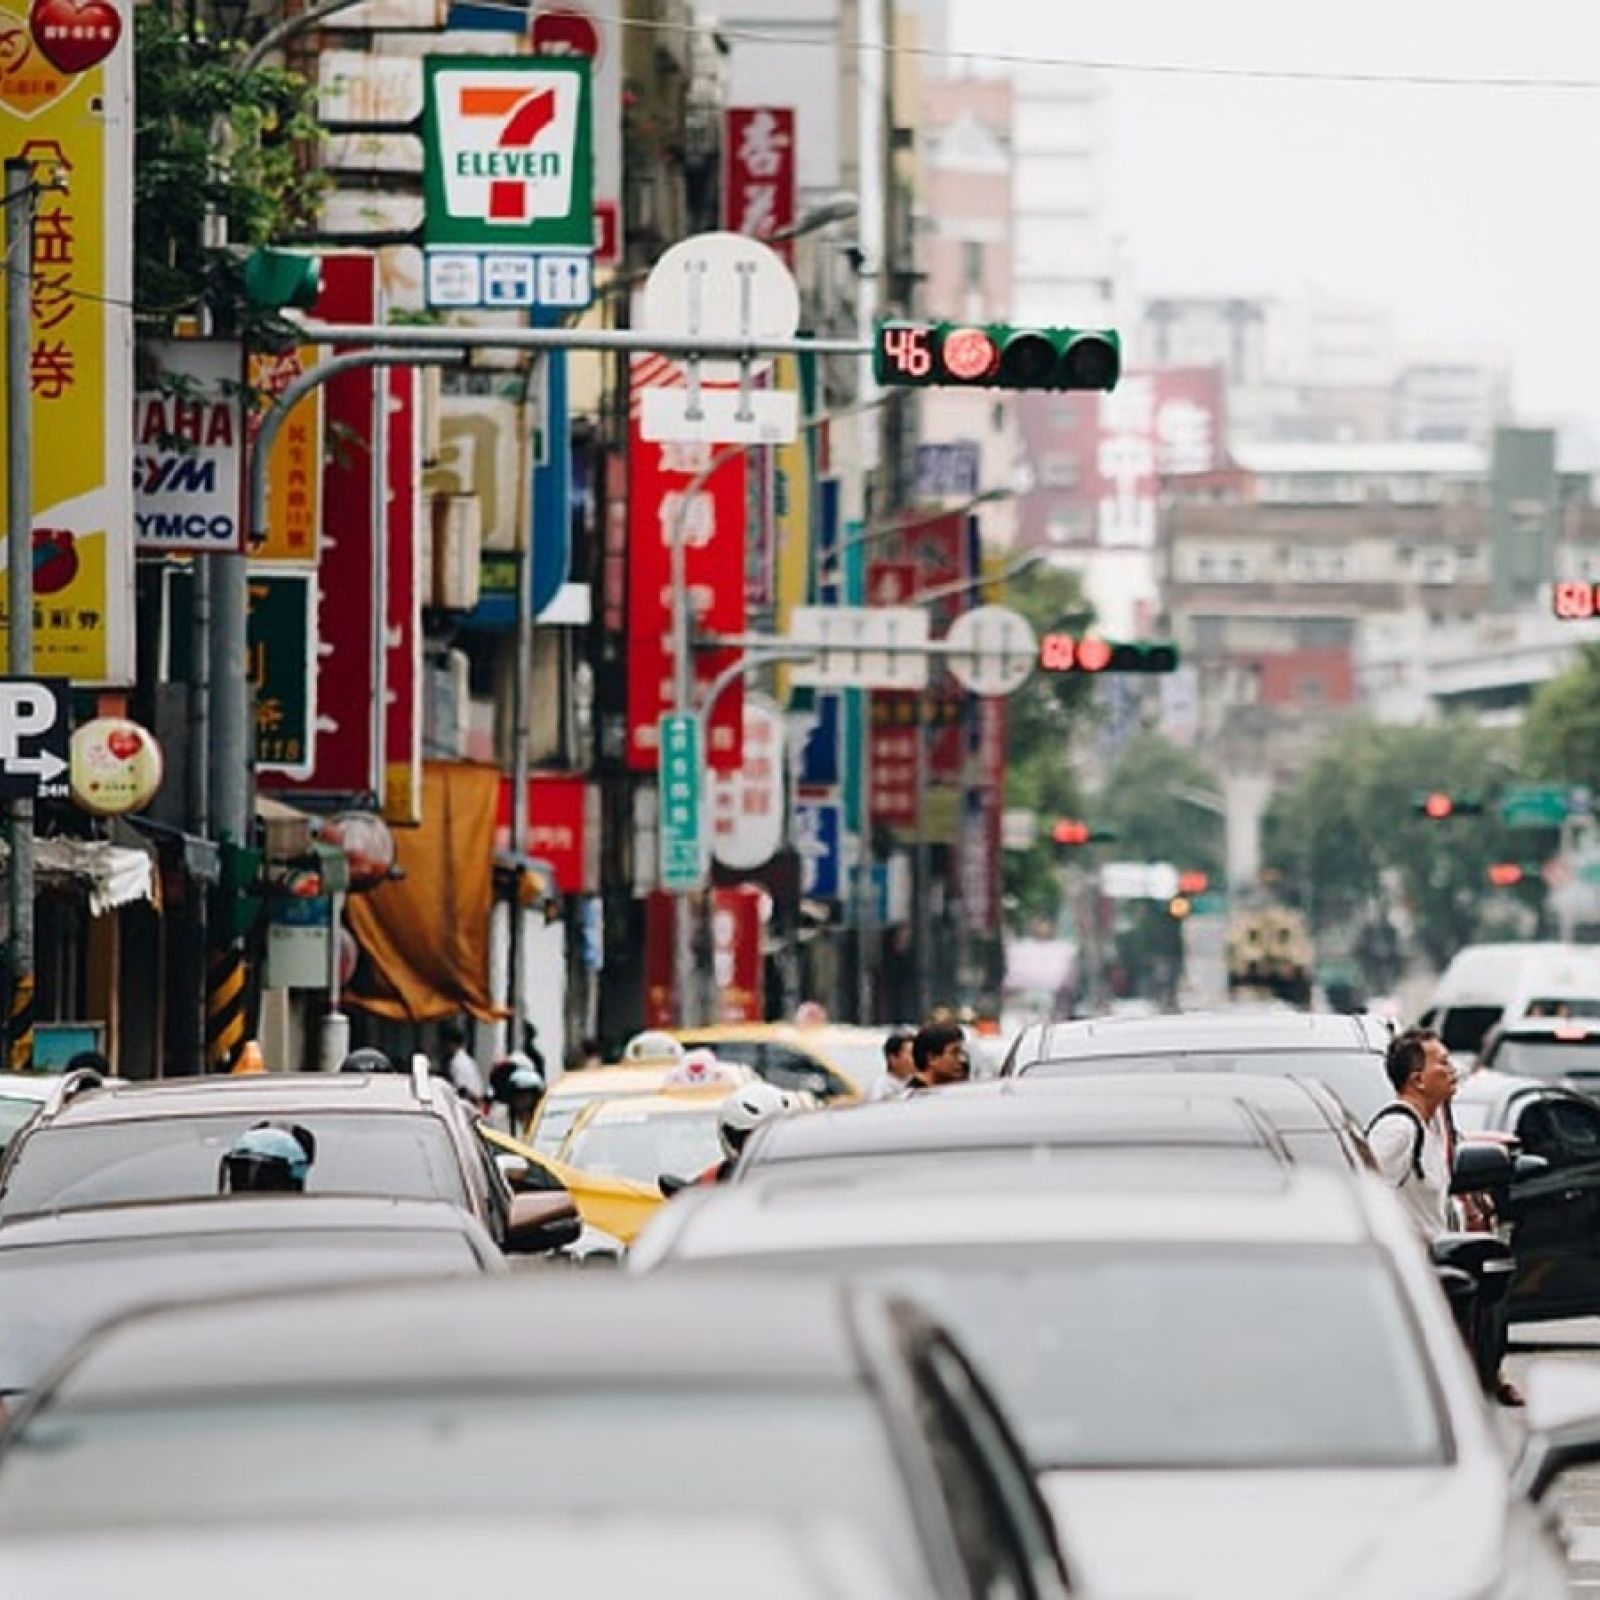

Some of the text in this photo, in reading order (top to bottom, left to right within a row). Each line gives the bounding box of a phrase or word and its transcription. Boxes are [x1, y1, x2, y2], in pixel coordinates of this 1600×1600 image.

[458, 87, 555, 218] 7
[885, 328, 931, 376] 46
[134, 399, 233, 446] AHA
[0, 682, 57, 759] P
